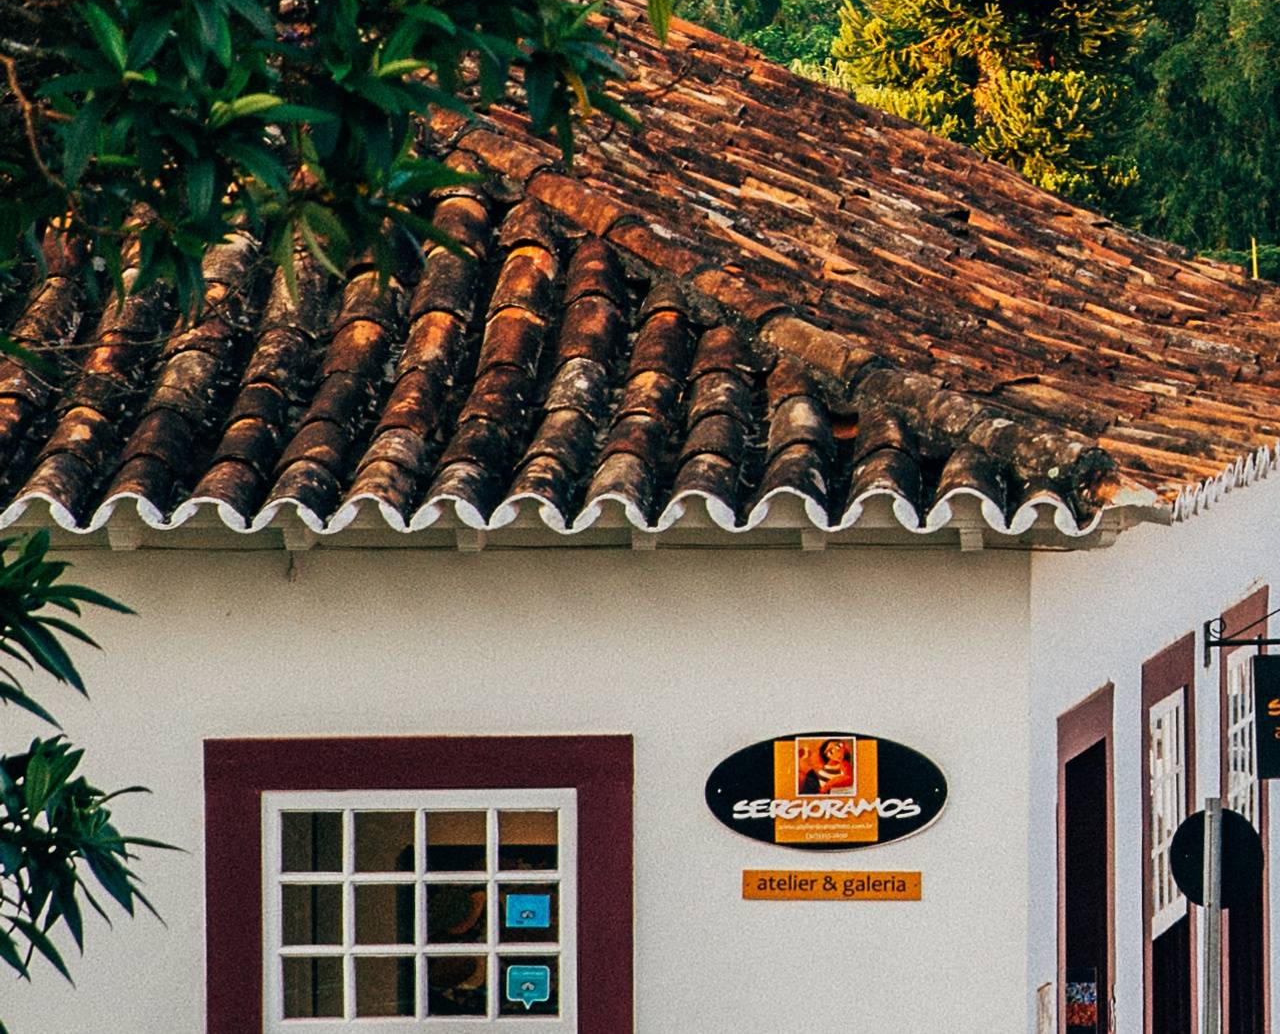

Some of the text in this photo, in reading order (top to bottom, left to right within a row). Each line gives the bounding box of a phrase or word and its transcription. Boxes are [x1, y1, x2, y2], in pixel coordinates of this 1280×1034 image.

[732, 798, 921, 820] SERGIORAMOS
[757, 875, 907, 897] atelier & galeria
